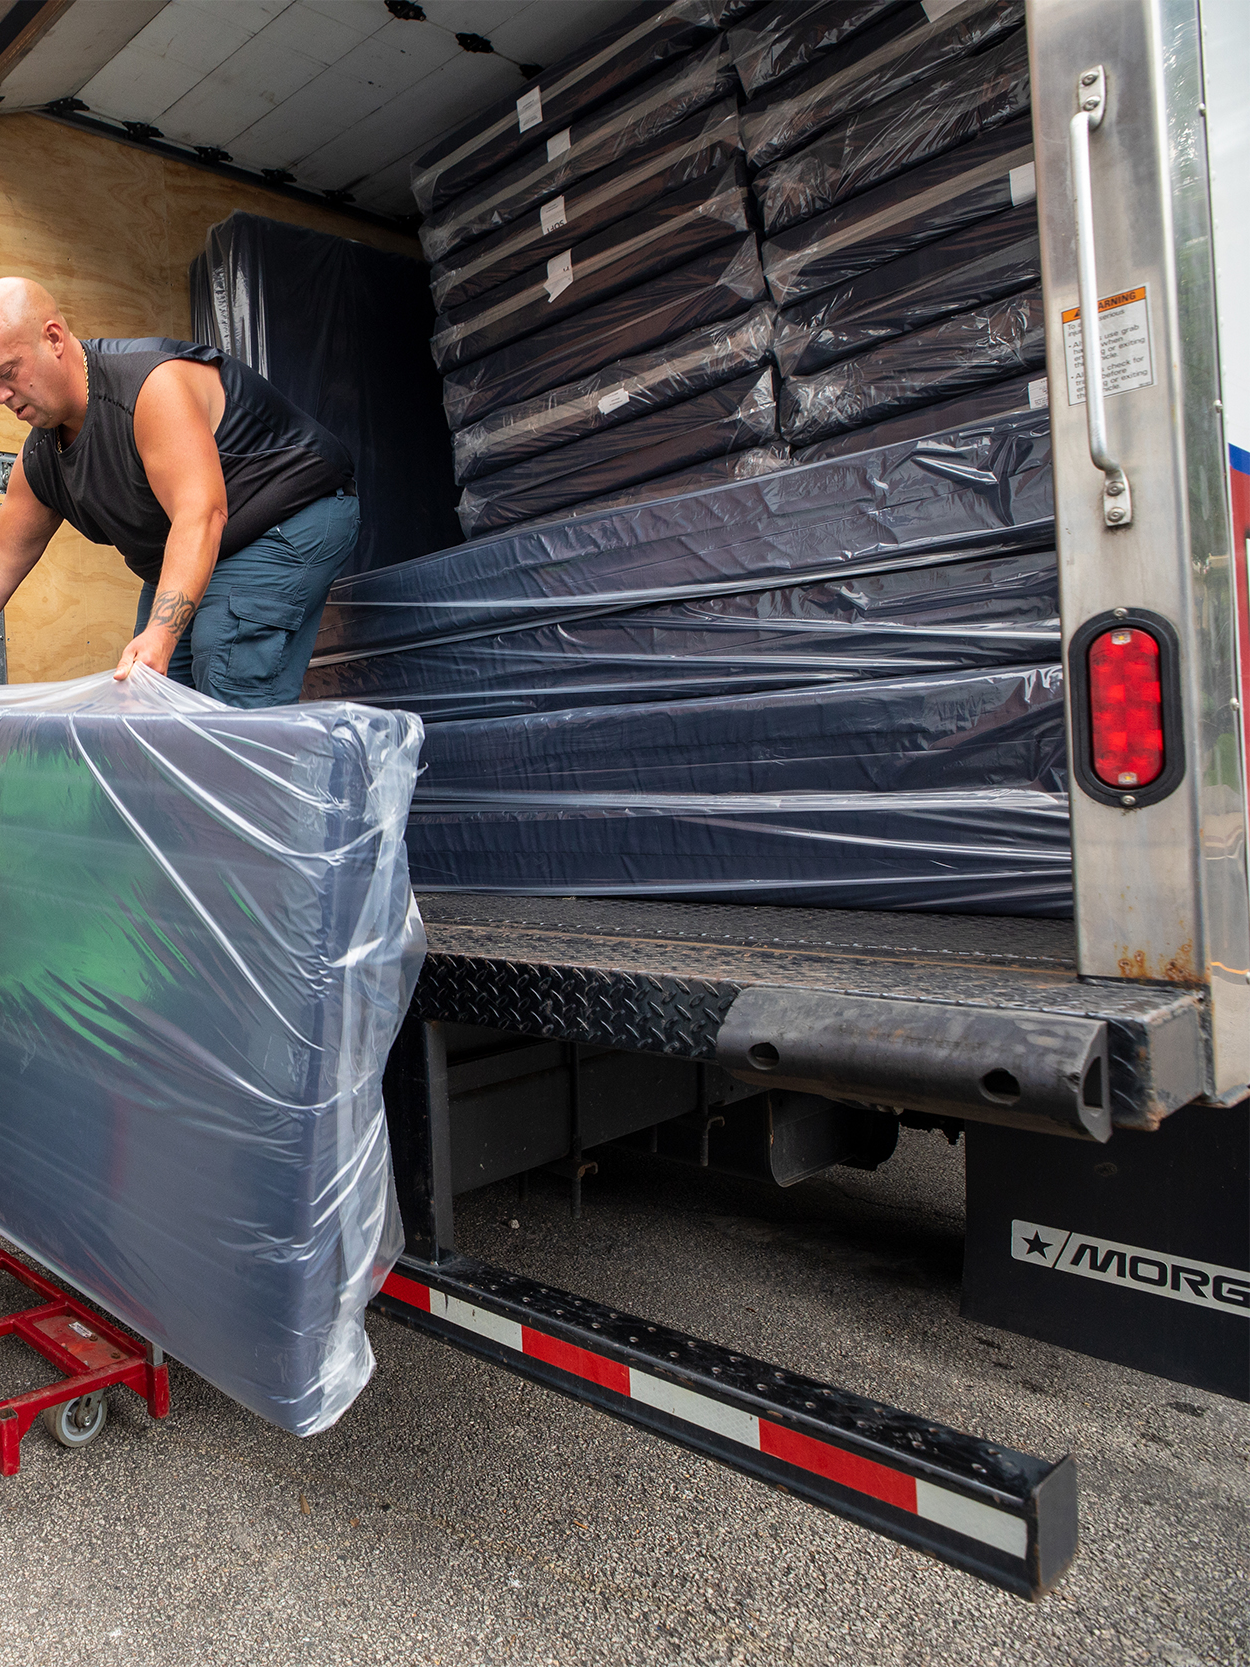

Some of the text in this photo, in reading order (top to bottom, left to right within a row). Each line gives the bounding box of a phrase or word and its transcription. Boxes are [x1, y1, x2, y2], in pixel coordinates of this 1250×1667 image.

[1097, 291, 1136, 310] ARNING
[1104, 331, 1119, 340] use
[1121, 324, 1139, 336] grab
[1118, 337, 1145, 350] exiting
[1107, 359, 1131, 371] check
[1121, 369, 1148, 381] exiting
[1070, 1243, 1250, 1309] MORG
